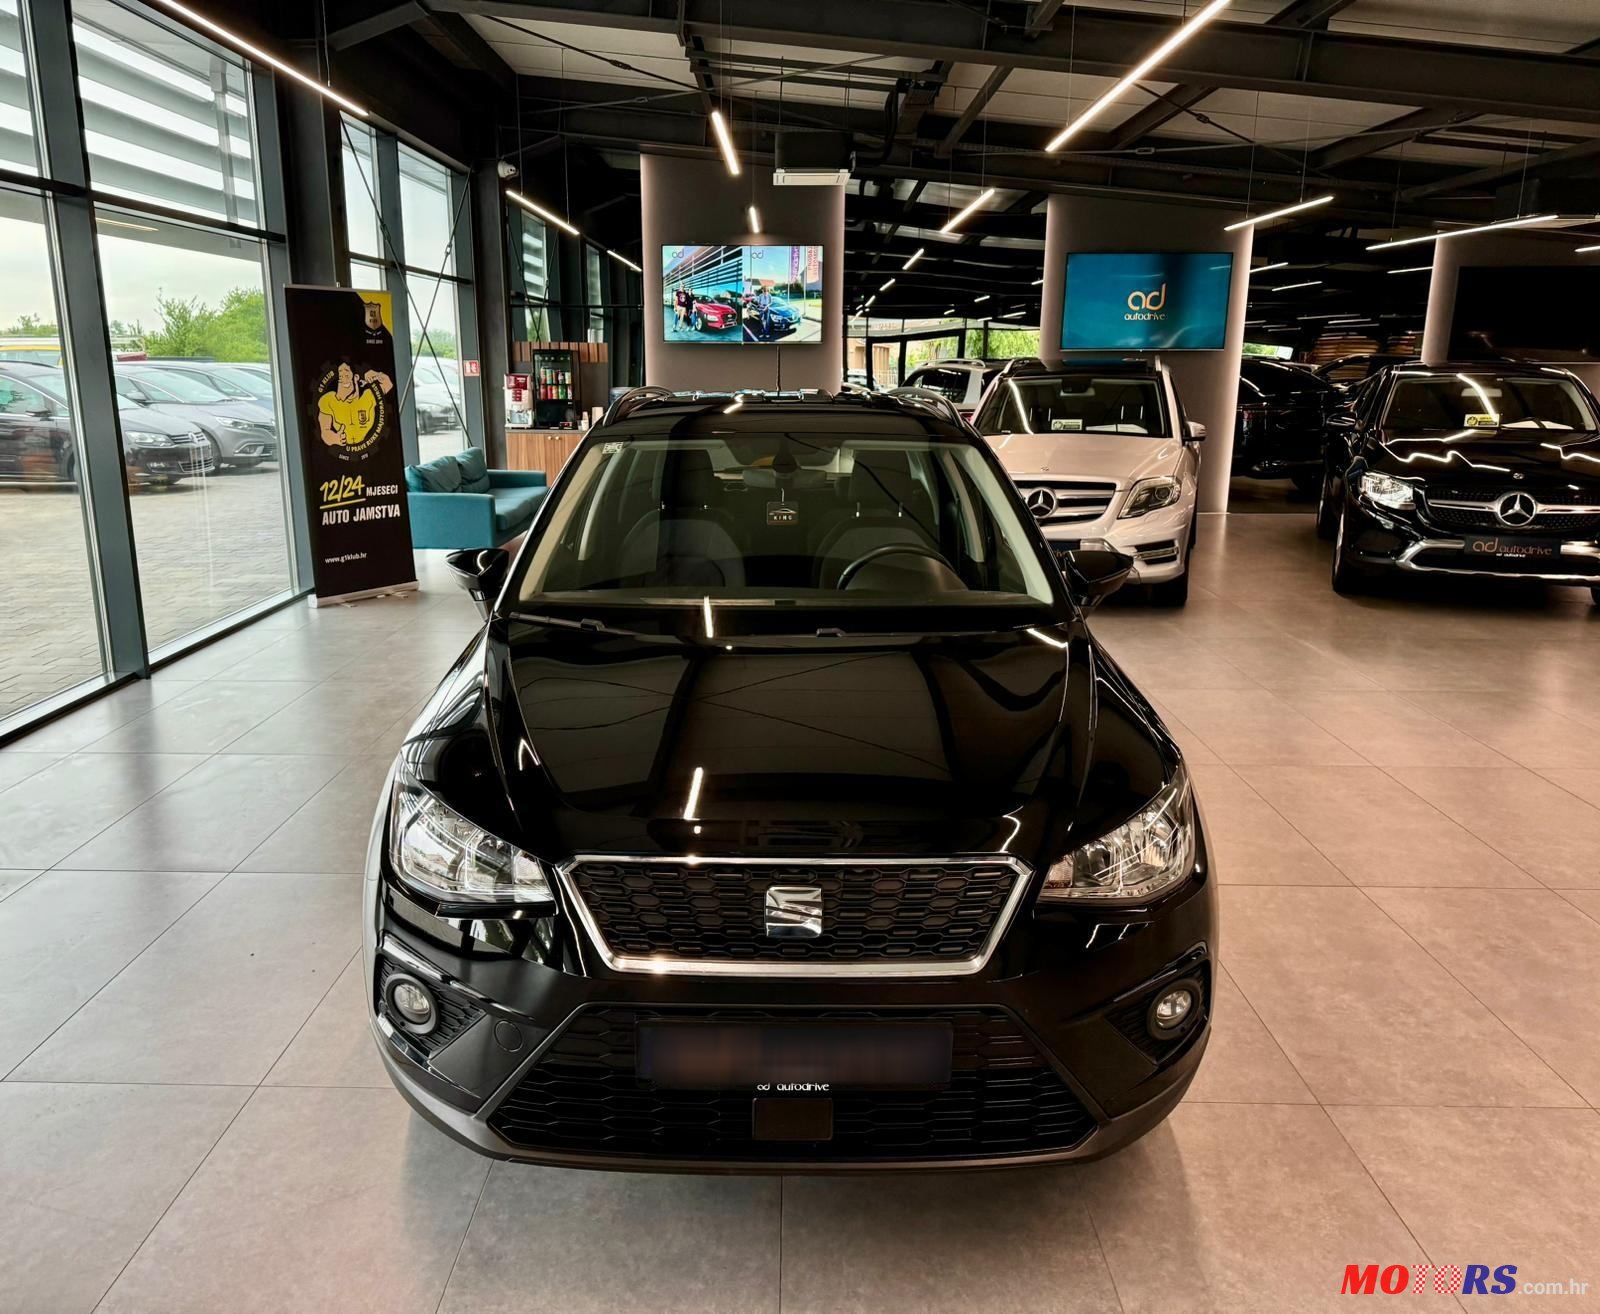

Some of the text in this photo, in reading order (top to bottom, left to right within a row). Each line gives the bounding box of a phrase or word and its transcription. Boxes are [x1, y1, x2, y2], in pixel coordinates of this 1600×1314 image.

[1127, 283, 1167, 311] ad
[1124, 312, 1166, 321] autodrive
[351, 444, 367, 452] PRAVE
[366, 432, 379, 447] RUKE
[376, 400, 385, 434] MAJSTORA
[320, 475, 398, 502] 12/24 MJESECI
[322, 504, 400, 526] AUTO JAMSTVA
[1472, 537, 1552, 556] ad autodrive
[325, 552, 367, 564] www.g1klub.hr
[757, 1082, 830, 1092] ad autodrive
